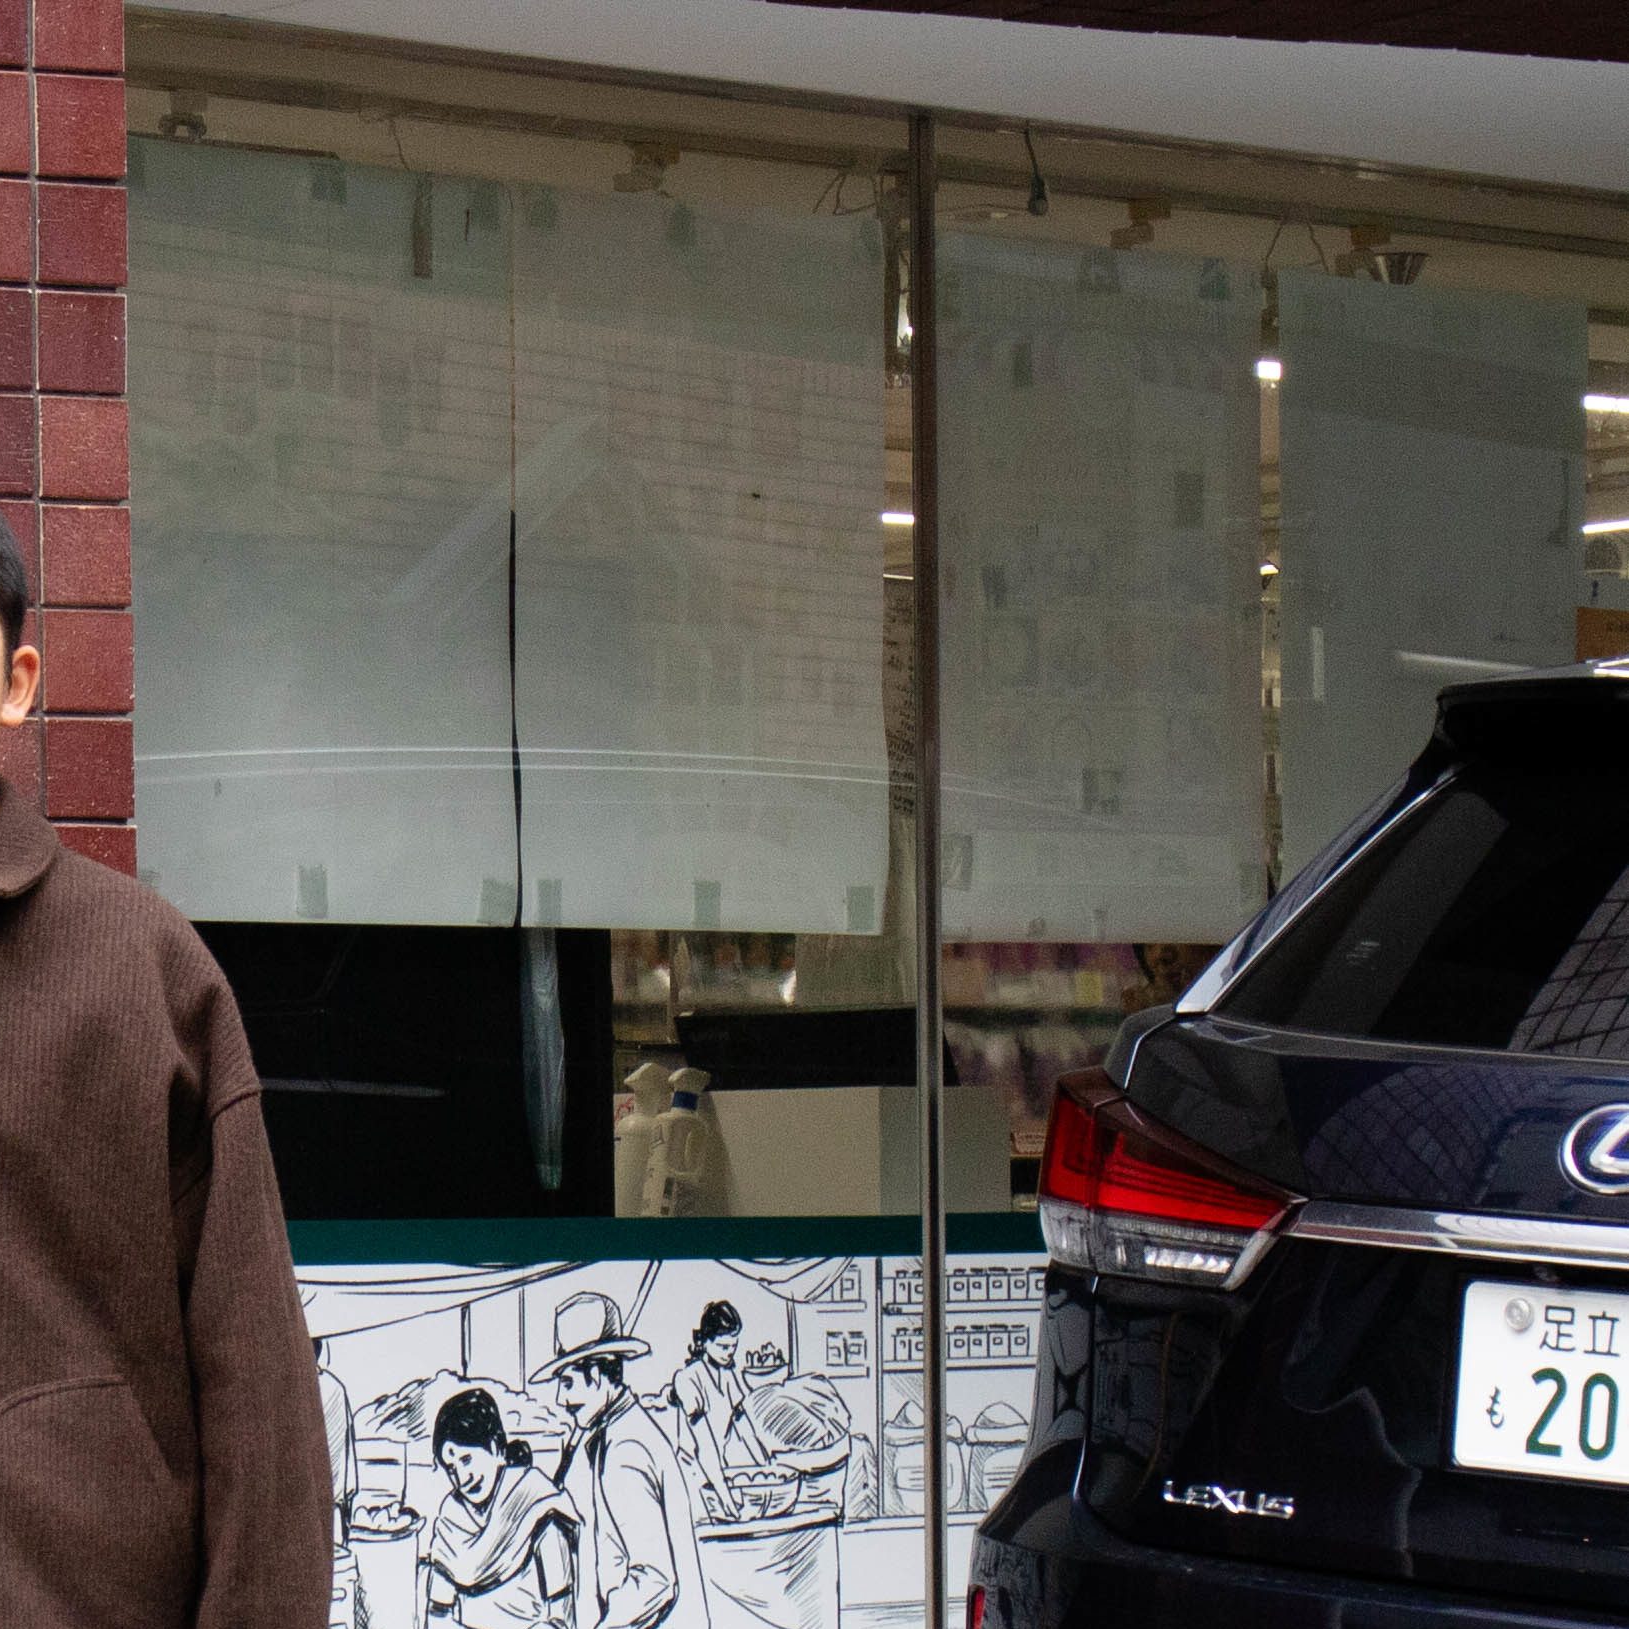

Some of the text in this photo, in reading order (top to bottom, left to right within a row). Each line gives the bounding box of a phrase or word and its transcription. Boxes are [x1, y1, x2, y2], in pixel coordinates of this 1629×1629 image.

[1539, 1304, 1620, 1357] 足立
[1486, 1367, 1619, 1461] も 20
[1163, 1480, 1294, 1519] LEXUS
